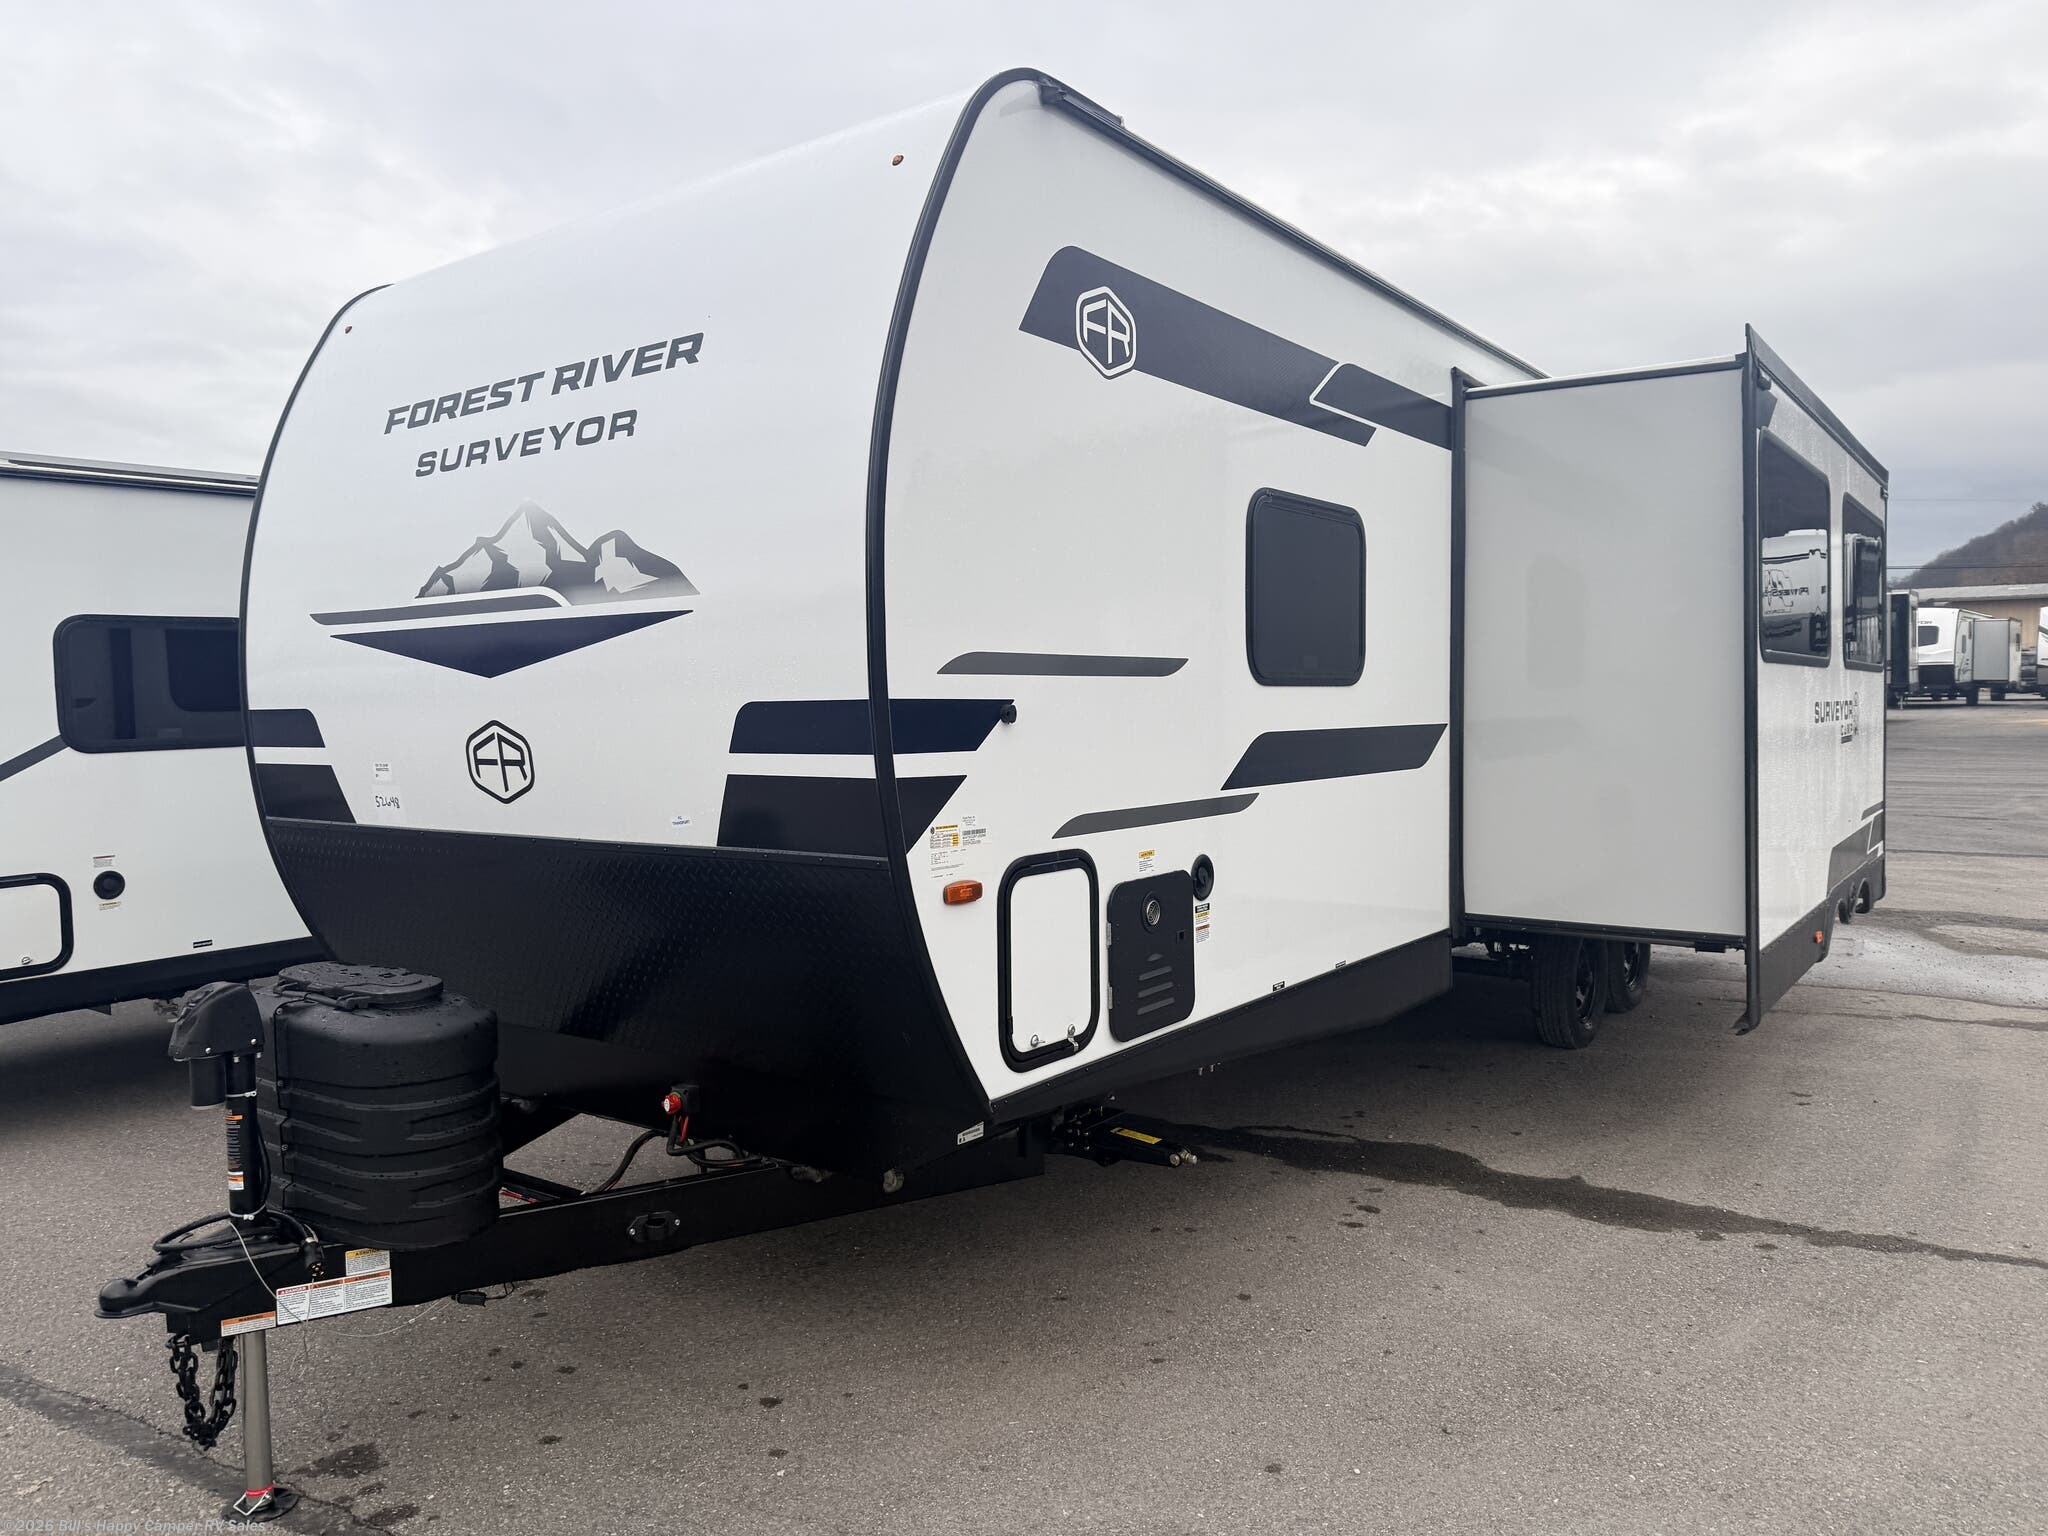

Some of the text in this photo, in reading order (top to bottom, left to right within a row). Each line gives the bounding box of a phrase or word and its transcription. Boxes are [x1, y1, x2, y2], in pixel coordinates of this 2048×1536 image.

[383, 331, 705, 435] FOREST RIVER
[415, 409, 638, 478] SURVEYOR
[1814, 700, 1853, 724] SURVEYOR
[374, 795, 400, 809] 52648
